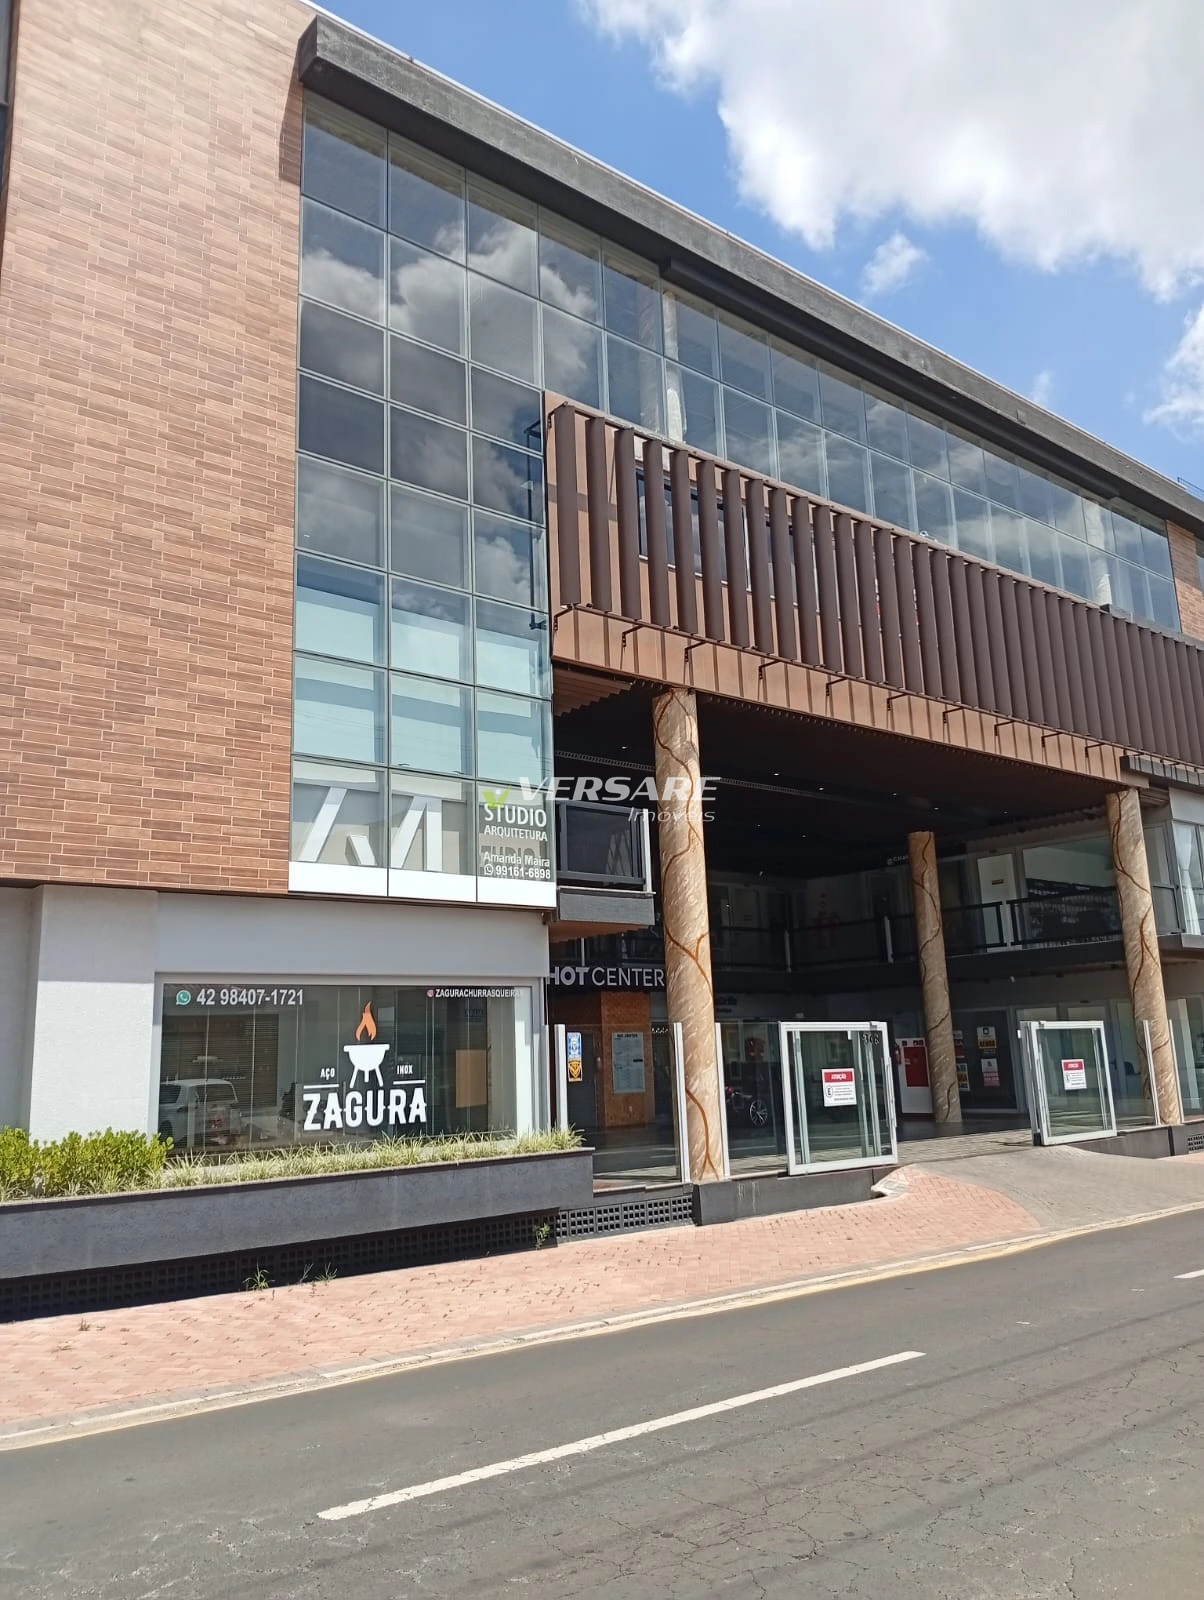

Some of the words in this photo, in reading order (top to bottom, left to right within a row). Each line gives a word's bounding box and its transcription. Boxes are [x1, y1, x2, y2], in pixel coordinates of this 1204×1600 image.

[484, 803, 547, 828] STUDIO
[484, 825, 548, 841] ARQUITETURA
[483, 851, 522, 865] Amanda
[524, 855, 550, 867] Maira
[495, 865, 551, 879] 99161-6898
[592, 967, 665, 987] CENTER
[196, 988, 217, 1006] 42
[220, 988, 304, 1006] 98407-1721
[320, 1066, 336, 1080] AÇO
[396, 1064, 413, 1076] INOX
[303, 1087, 427, 1131] ZAGURA
